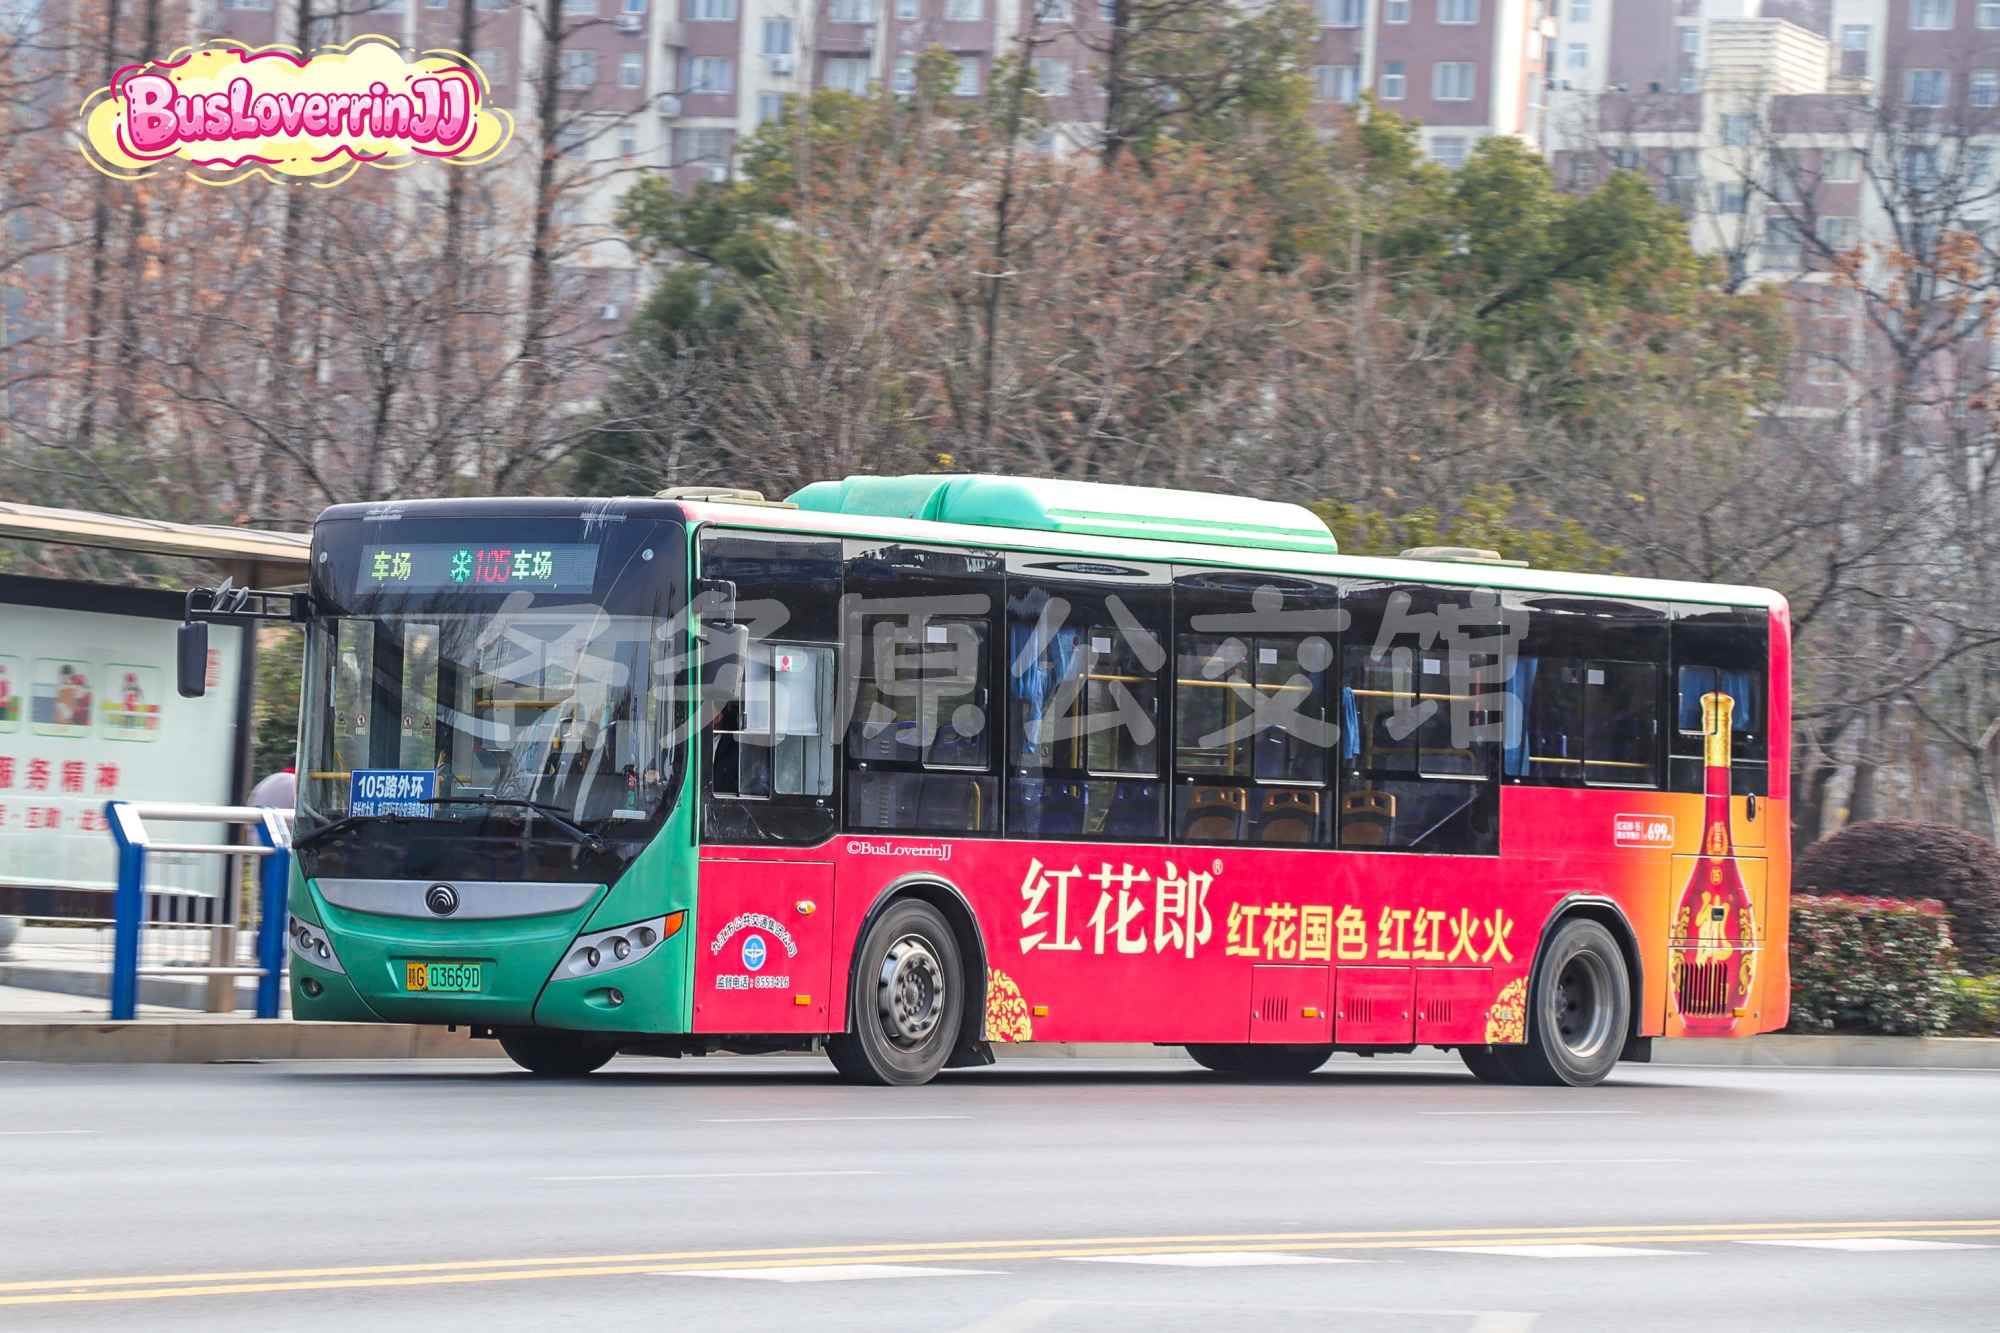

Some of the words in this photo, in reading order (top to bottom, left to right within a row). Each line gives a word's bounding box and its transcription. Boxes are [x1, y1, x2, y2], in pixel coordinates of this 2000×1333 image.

[371, 551, 412, 580] 车场
[358, 775, 425, 799] 105路外环
[711, 912, 798, 957] 九江市公共交通集团公司
[1225, 901, 1369, 961] 红花国色
[1378, 905, 1514, 963] 红红火火
